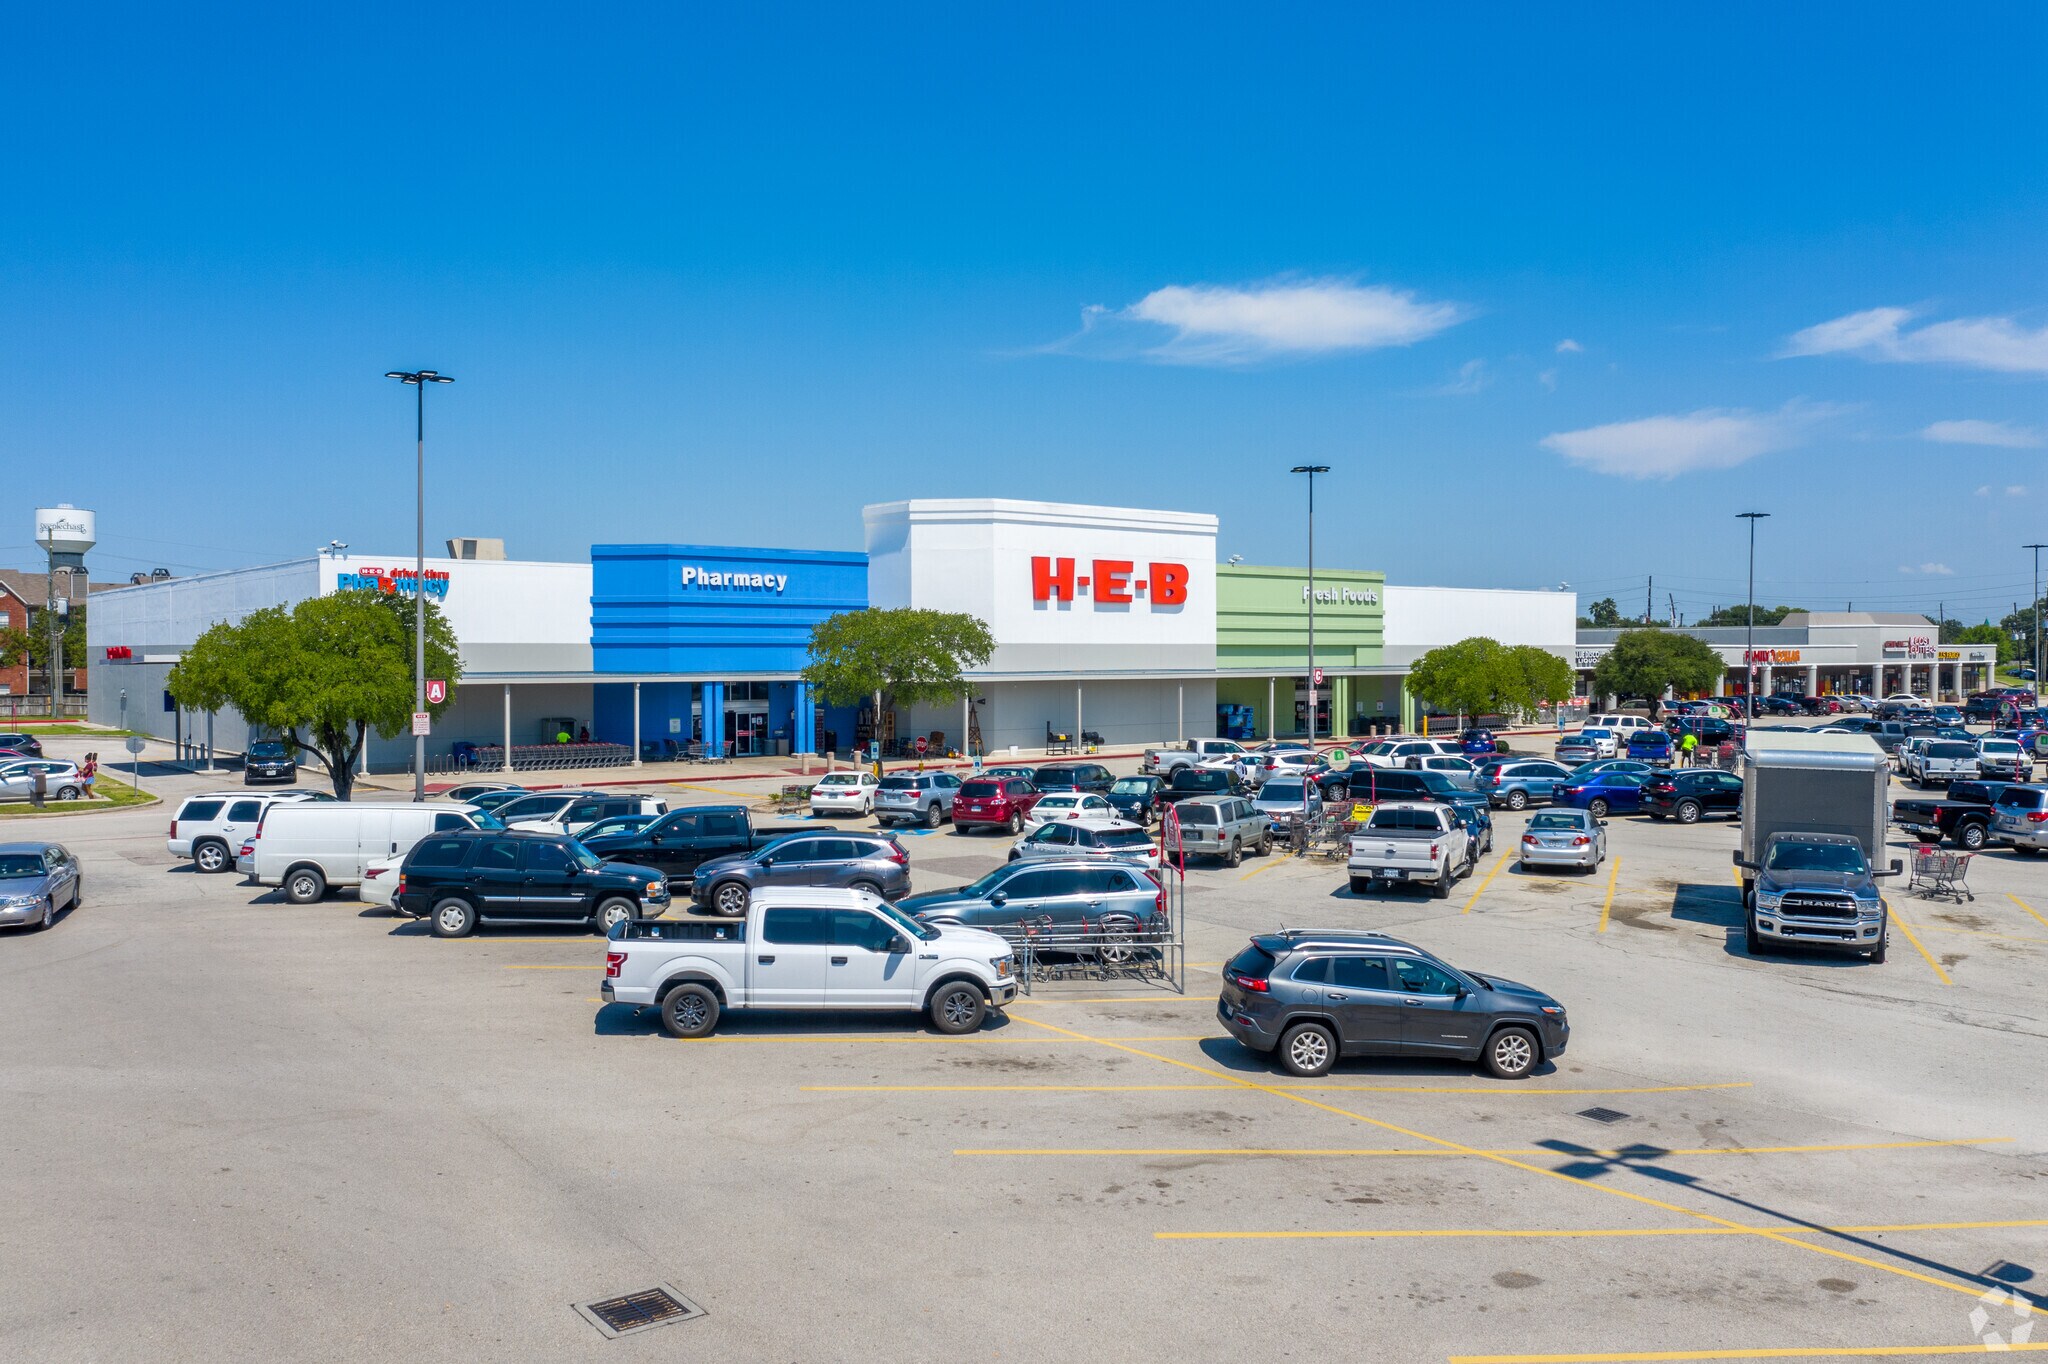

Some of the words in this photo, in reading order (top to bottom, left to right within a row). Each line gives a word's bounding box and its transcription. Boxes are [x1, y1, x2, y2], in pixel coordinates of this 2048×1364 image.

[682, 566, 788, 592] Pharmacy
[1031, 556, 1189, 604] H-E-B
[1342, 586, 1377, 602] Foods
[1315, 670, 1321, 681] C
[430, 683, 442, 698] A
[916, 740, 927, 748] STOP
[1803, 900, 1836, 908] RAM
